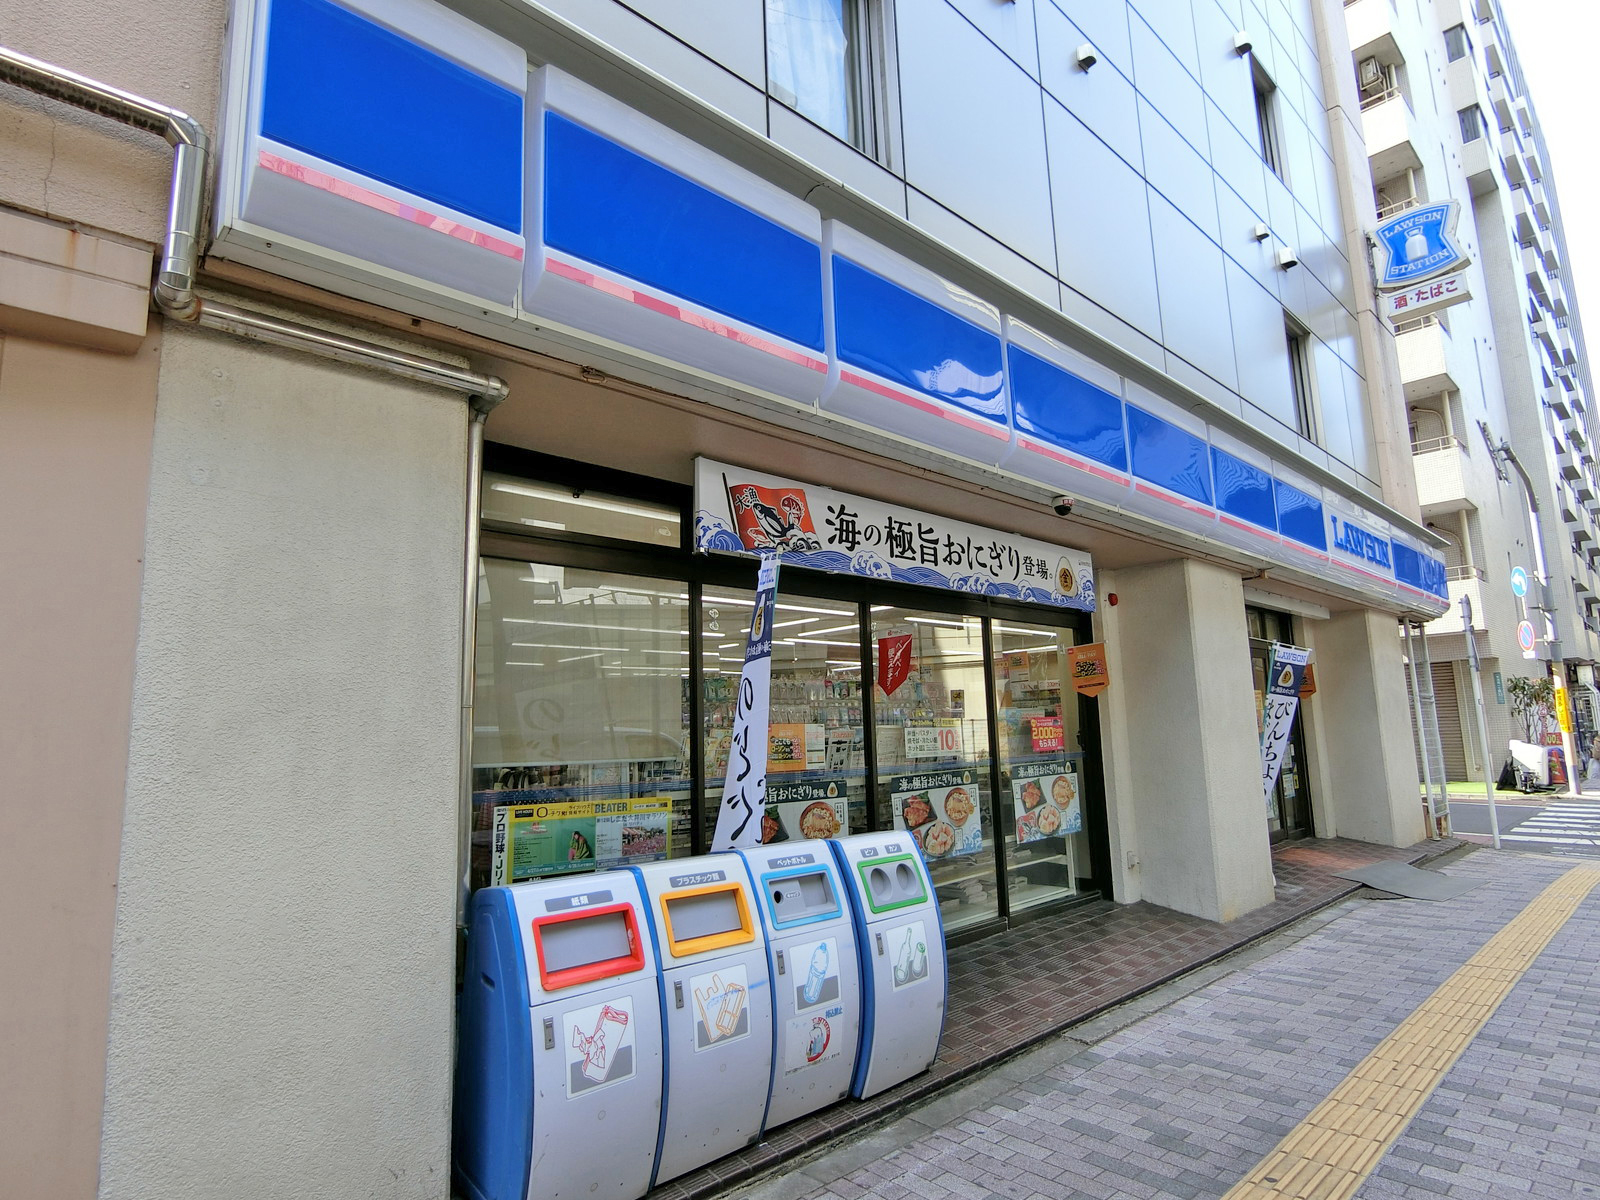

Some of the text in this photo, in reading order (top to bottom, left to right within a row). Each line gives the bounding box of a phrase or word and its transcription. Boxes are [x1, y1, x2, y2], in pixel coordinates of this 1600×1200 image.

[1383, 211, 1443, 238] LAWSON
[1391, 248, 1449, 275] STATION
[1393, 279, 1458, 309] 酒・たばこ
[735, 487, 760, 514] 大漁
[1330, 514, 1391, 569] LAWSON
[1277, 649, 1306, 663] LAWSON
[594, 803, 628, 813] BEATER
[864, 848, 875, 857] ビン
[777, 856, 807, 866] ペットボトル
[676, 873, 721, 886] プラスチック類
[571, 895, 589, 906] 紙類
